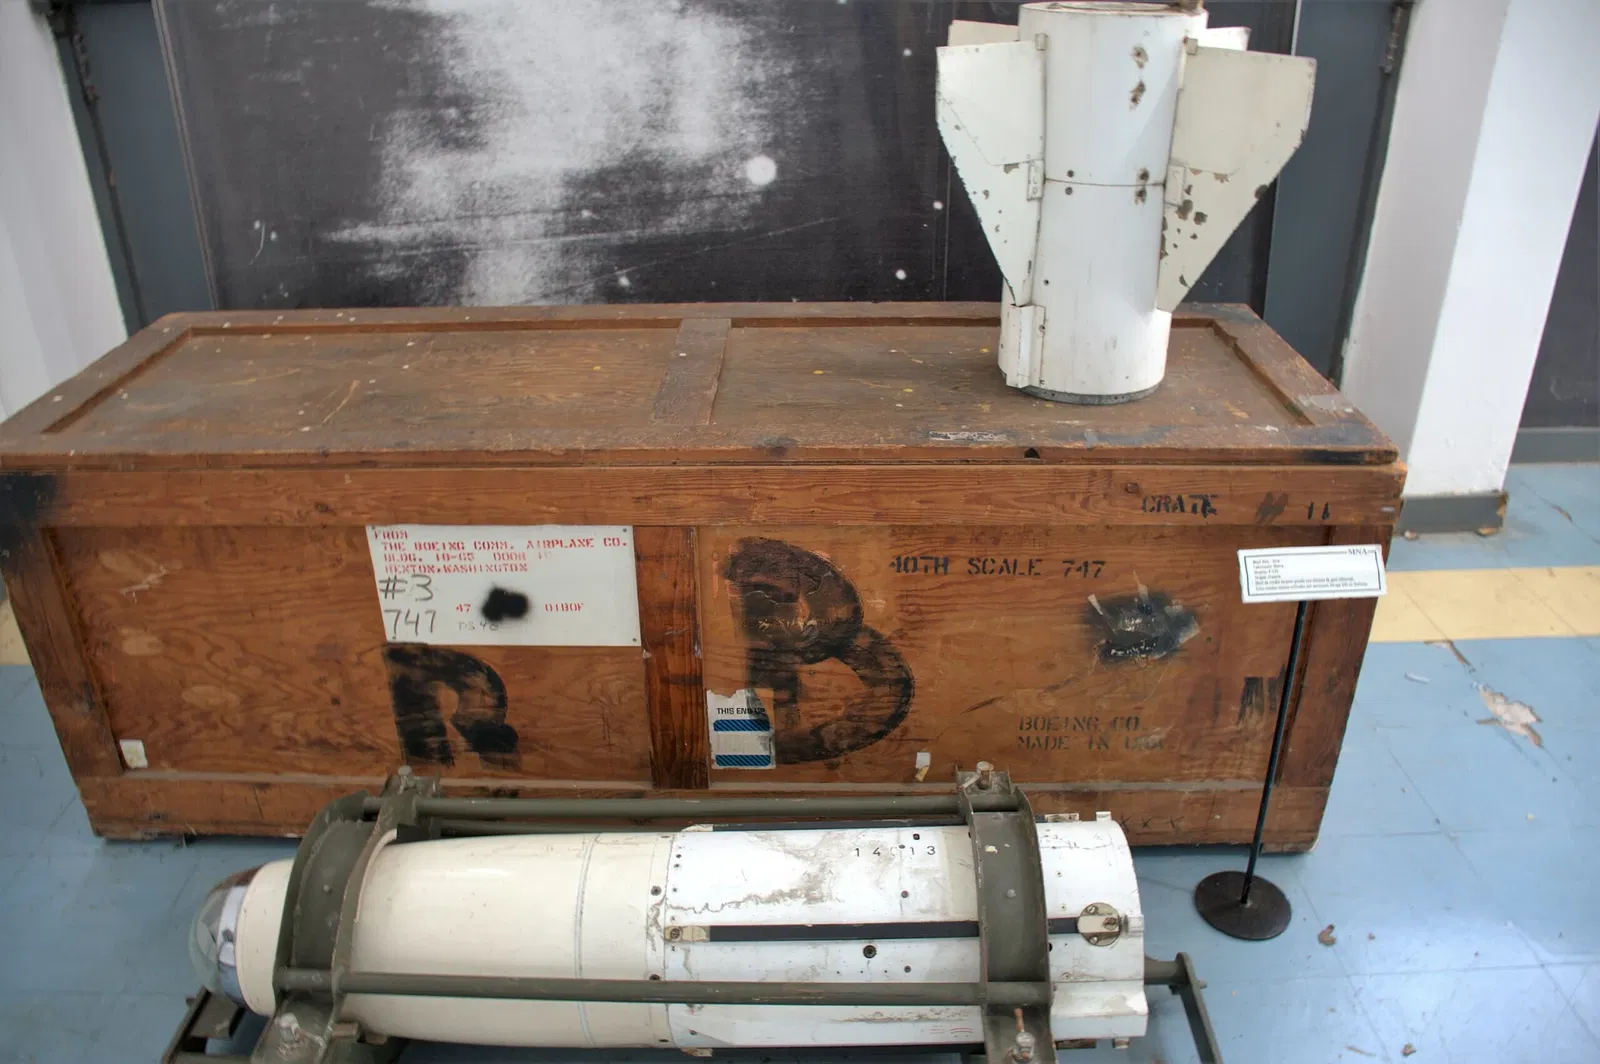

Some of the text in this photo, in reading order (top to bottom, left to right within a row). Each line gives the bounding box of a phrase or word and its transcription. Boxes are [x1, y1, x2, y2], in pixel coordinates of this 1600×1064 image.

[1141, 494, 1219, 518] CRATE
[374, 530, 408, 540] FROM
[382, 536, 627, 551] THE BOEING COMM. AIRPLANE CO.
[493, 551, 526, 561] DOOR
[1346, 547, 1368, 556] MNA
[967, 557, 1042, 576] SCALE
[1062, 559, 1106, 578] 747
[384, 608, 436, 638] 747
[716, 707, 735, 715] THIS
[736, 707, 752, 715] END
[1018, 715, 1100, 732] BOEING
[1016, 735, 1071, 751] MADE
